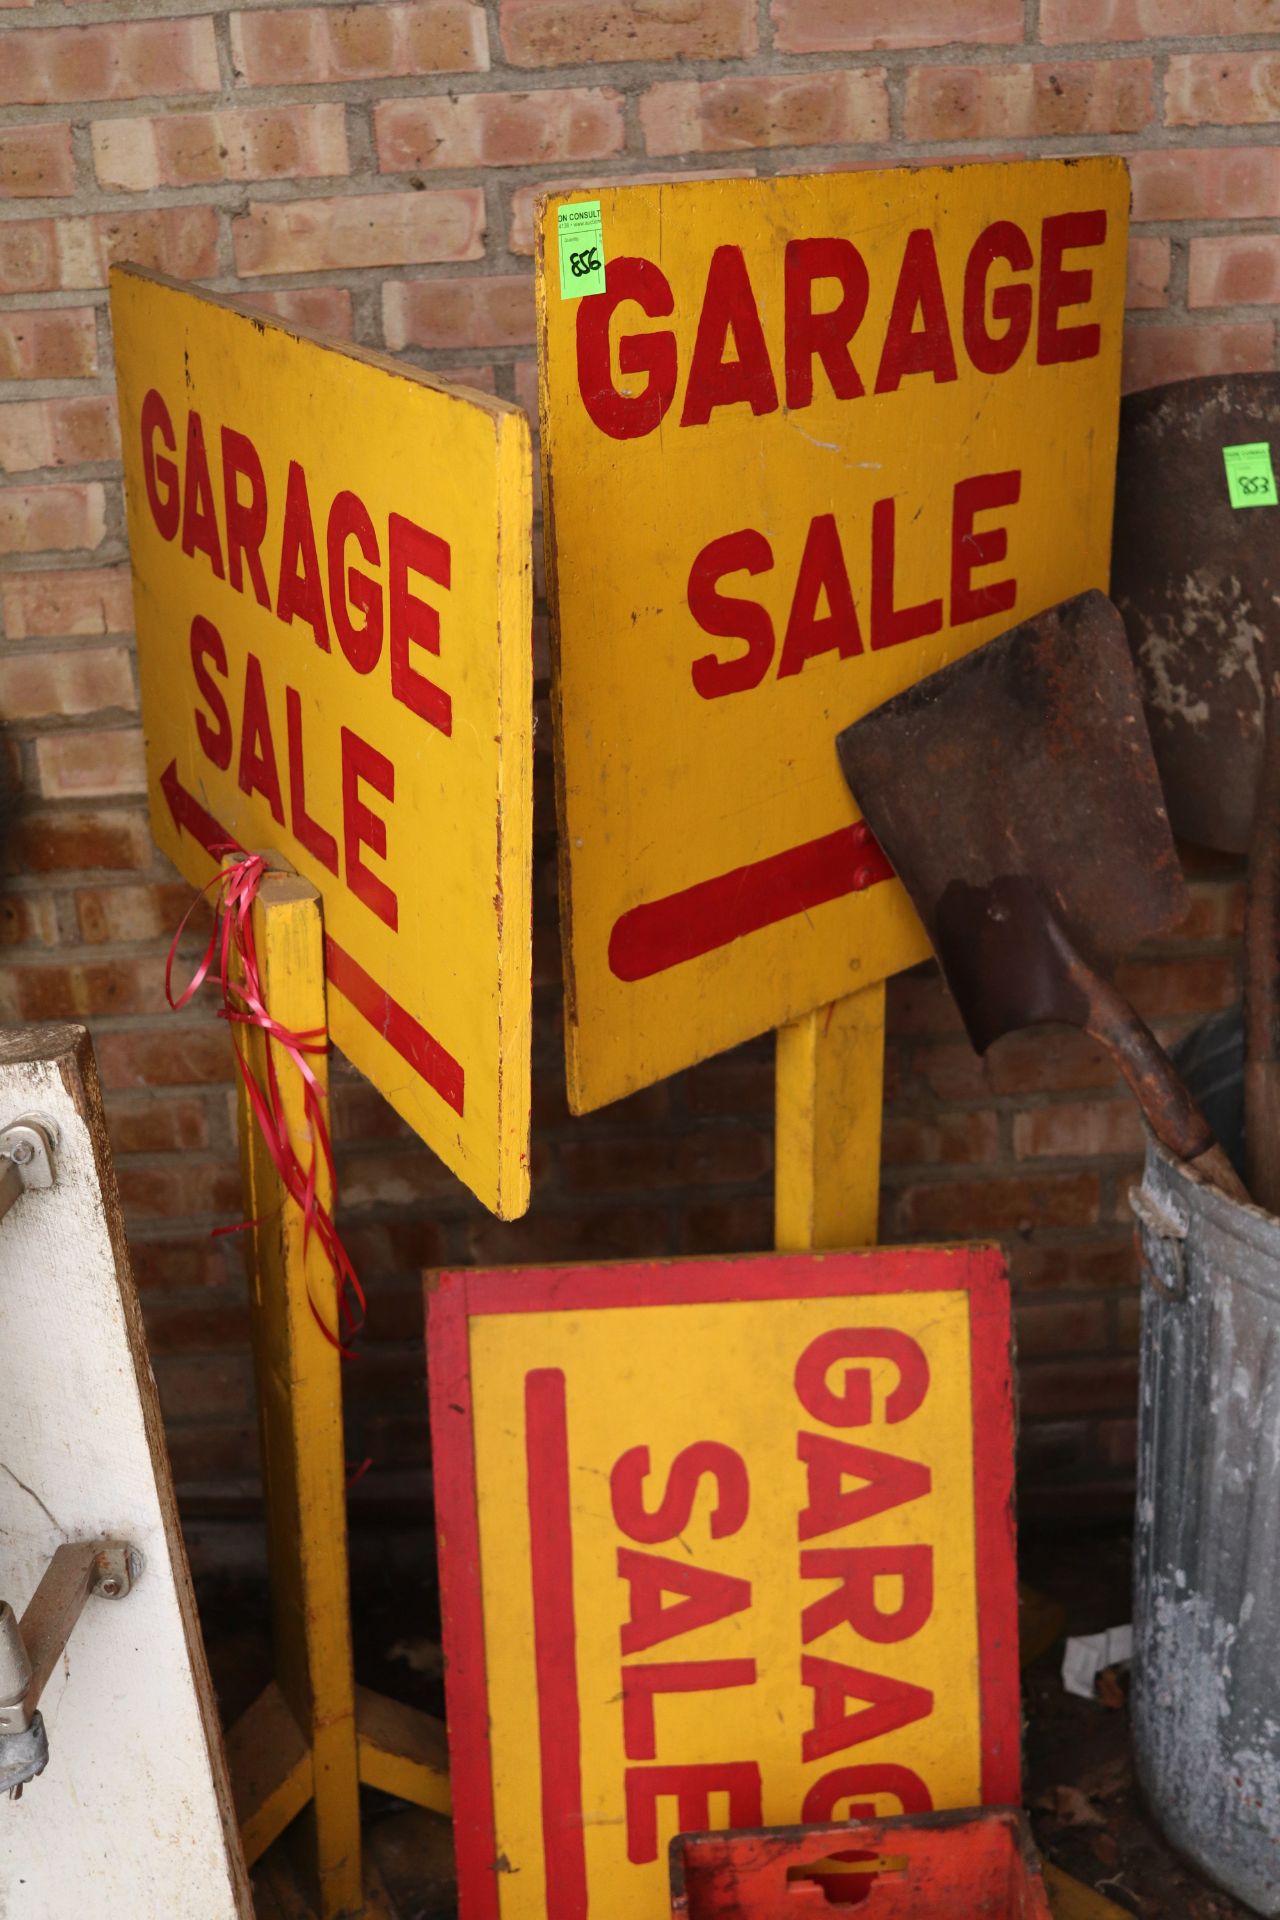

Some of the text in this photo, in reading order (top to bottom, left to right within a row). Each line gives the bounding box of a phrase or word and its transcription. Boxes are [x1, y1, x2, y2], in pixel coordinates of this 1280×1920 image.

[569, 210, 601, 221] CONSULT
[570, 247, 601, 277] 856
[576, 209, 1107, 440] GARAGE
[141, 389, 452, 737] GARAGE
[687, 470, 1021, 700] SALE
[190, 614, 398, 933] SALE
[610, 1440, 763, 1864] SALE
[794, 1327, 934, 1824] GARAG
